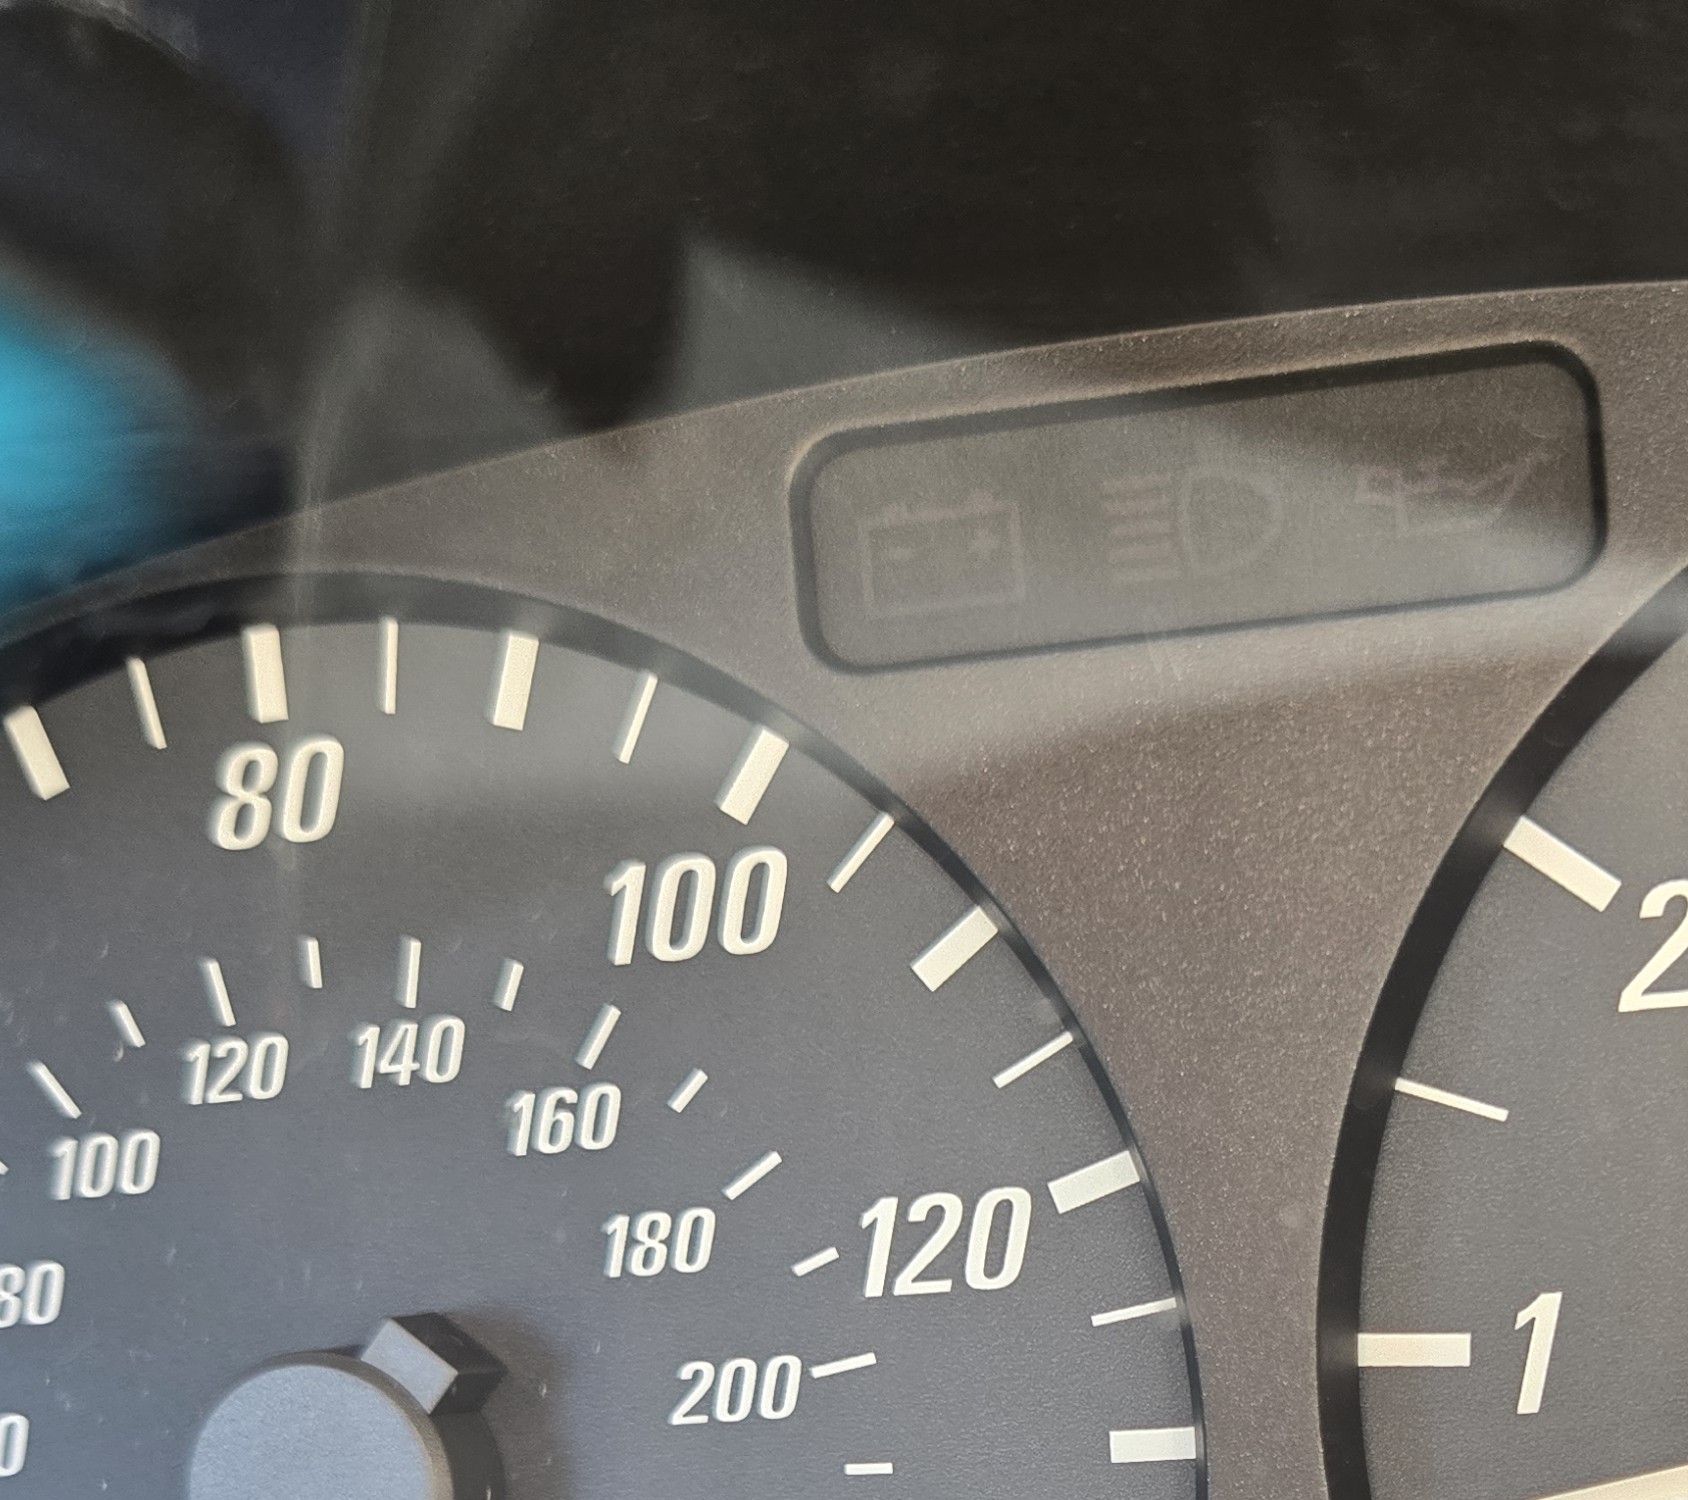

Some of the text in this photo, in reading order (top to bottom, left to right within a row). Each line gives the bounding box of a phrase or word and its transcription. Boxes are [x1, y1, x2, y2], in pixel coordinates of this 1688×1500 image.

[213, 736, 344, 850] 80
[610, 847, 788, 965] 100
[186, 1034, 289, 1105] 120
[356, 1016, 465, 1089] 140
[512, 1083, 621, 1156] 160
[53, 1130, 160, 1200] 100
[605, 1207, 716, 1278] 180
[861, 1186, 1032, 1298] 120
[0, 1261, 64, 1328] 80
[1514, 1291, 1563, 1414] 1
[670, 1354, 802, 1426] 200
